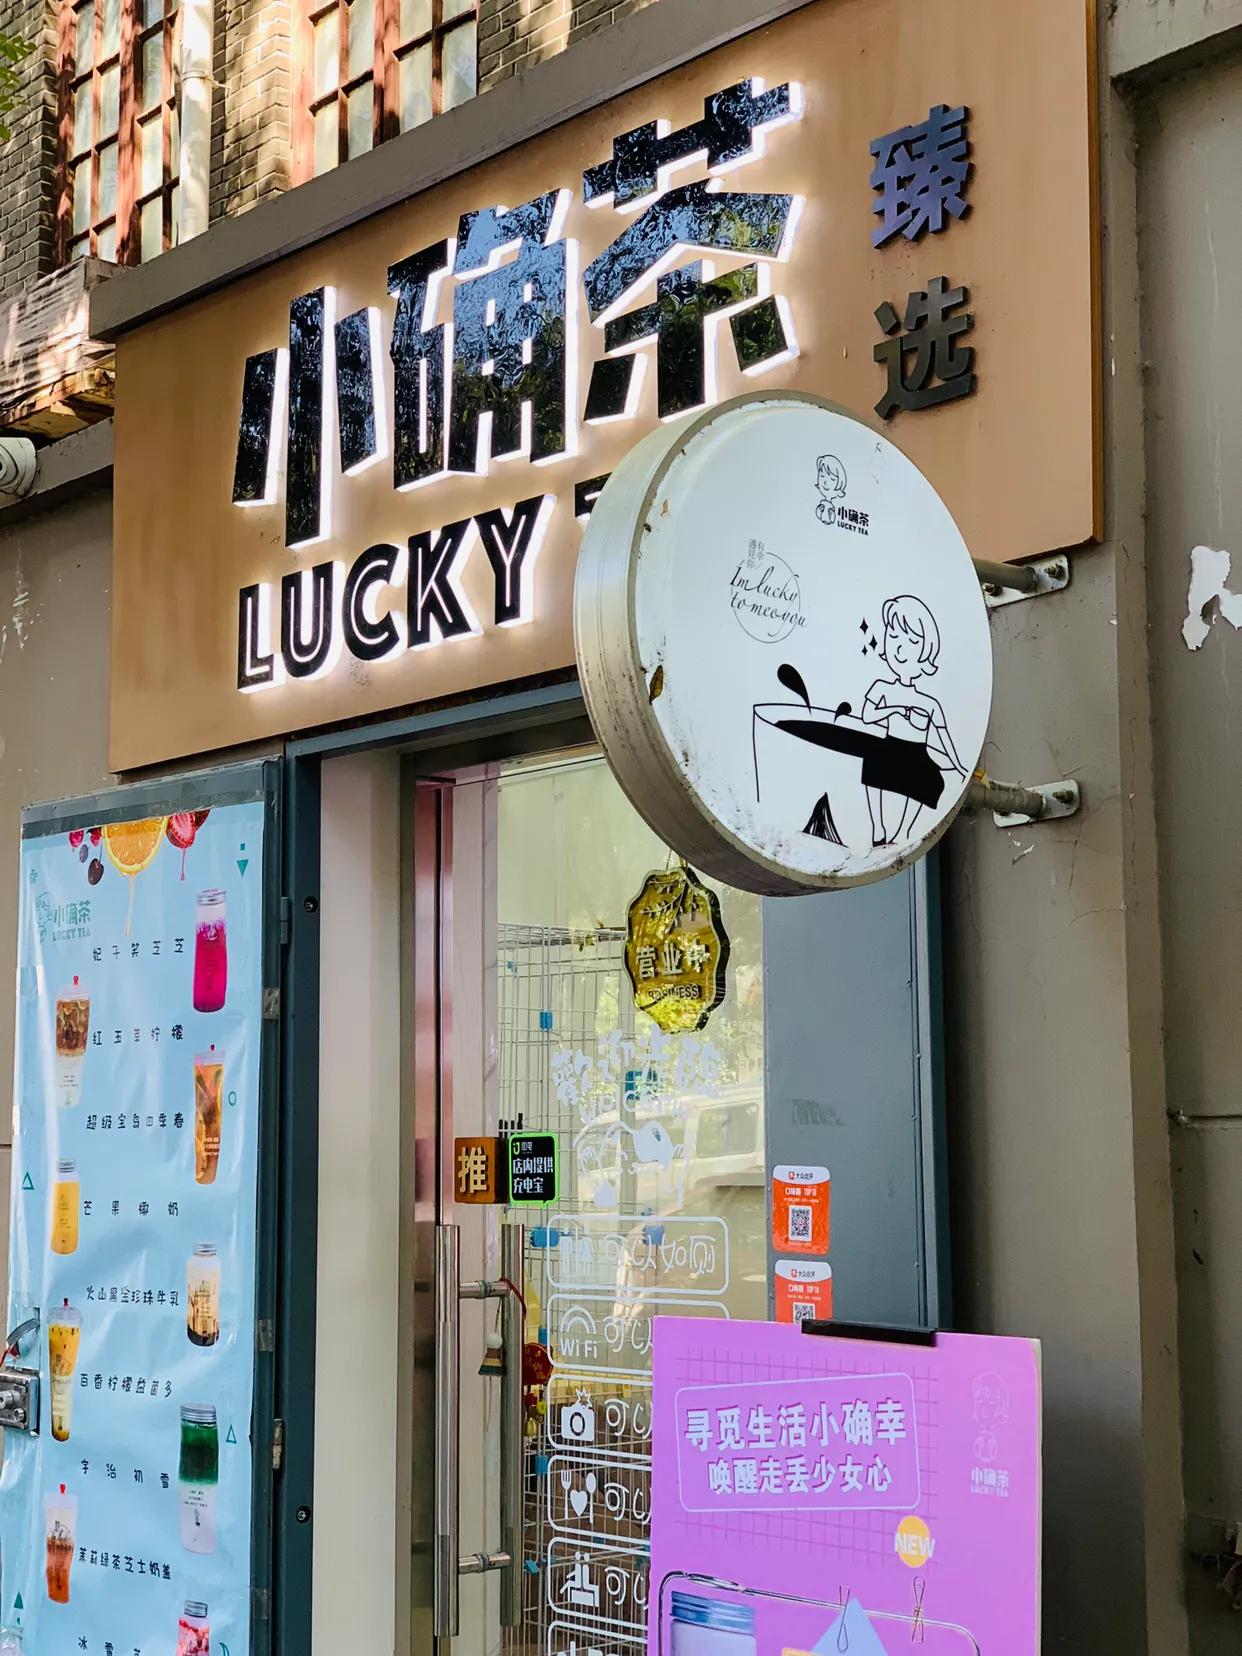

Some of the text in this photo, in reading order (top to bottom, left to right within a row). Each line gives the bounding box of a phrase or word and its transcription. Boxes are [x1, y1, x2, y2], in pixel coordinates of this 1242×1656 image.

[869, 103, 977, 421] 臻选
[836, 520, 869, 536] LUCKY TEA
[238, 495, 557, 693] LUCKY
[77, 927, 91, 938] TEA
[458, 1146, 487, 1194] 推
[512, 1156, 554, 1175] 店内提供
[513, 1176, 545, 1194] 充电宝
[83, 1200, 179, 1217] 芒果椰奶
[560, 1338, 598, 1360] WiFi
[684, 1397, 908, 1453] 寻觅生活小确幸
[80, 1458, 170, 1489] 宇治初雪
[706, 1454, 894, 1496] 唤醒走丢少女心
[894, 1531, 936, 1558] NEW
[79, 1547, 171, 1580] 茉莉绿茶芝士奶盖
